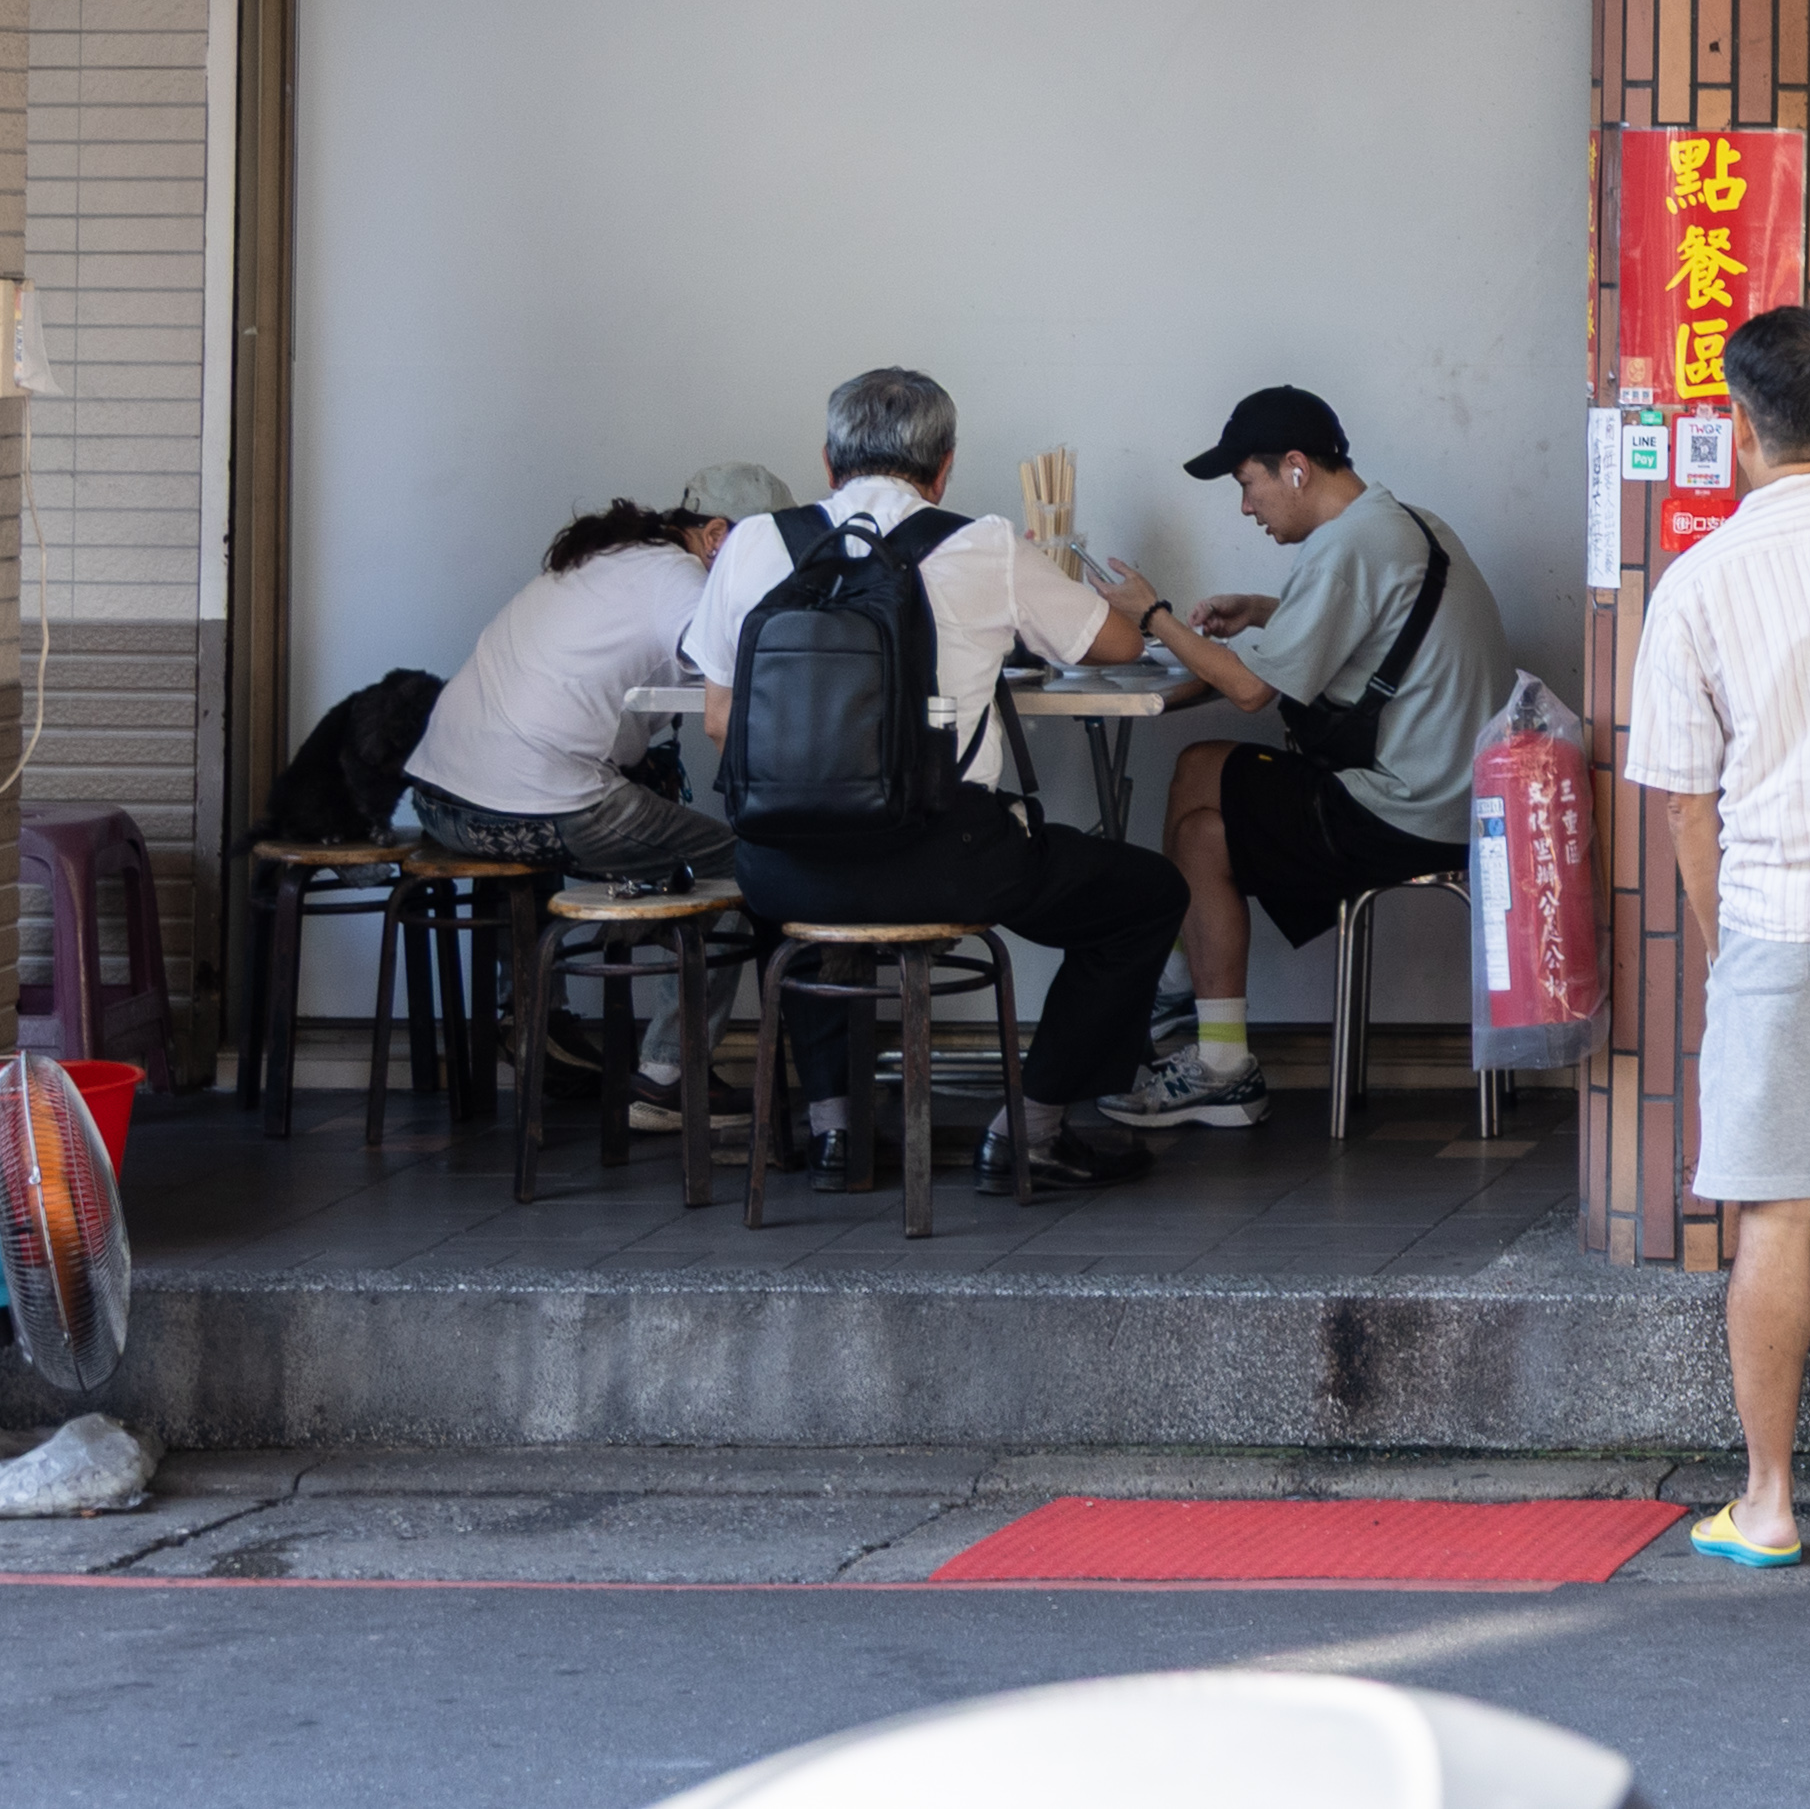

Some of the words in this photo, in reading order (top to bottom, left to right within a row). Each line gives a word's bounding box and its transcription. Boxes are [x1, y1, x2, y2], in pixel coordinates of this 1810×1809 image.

[1665, 138, 1748, 400] 點餐區
[1632, 436, 1657, 447] LINE
[1634, 452, 1655, 468] Pay
